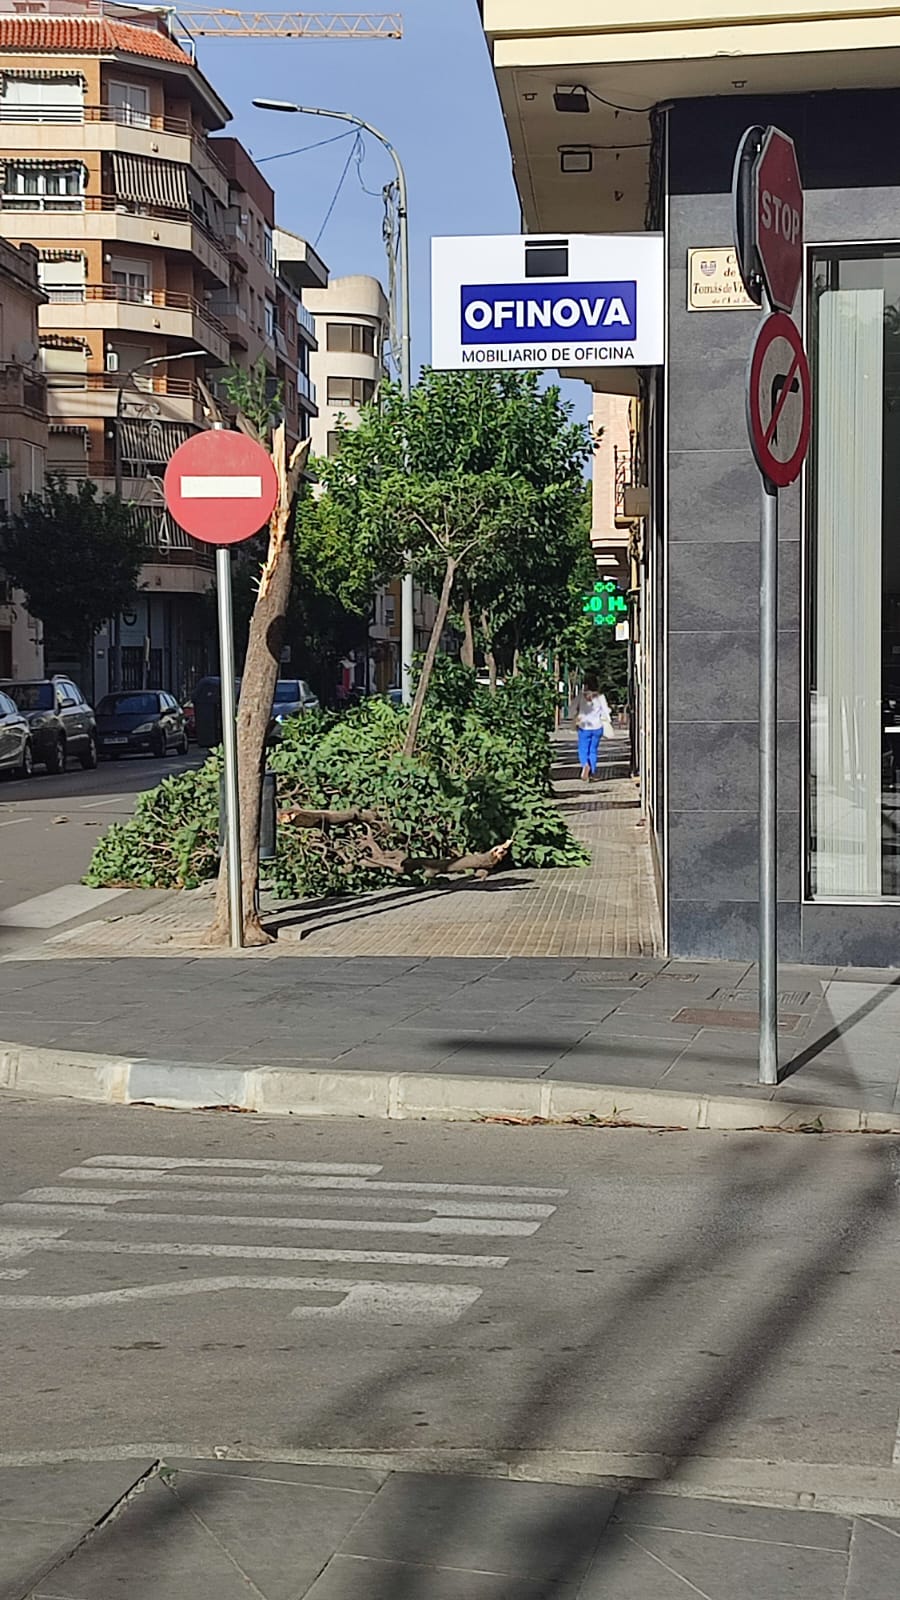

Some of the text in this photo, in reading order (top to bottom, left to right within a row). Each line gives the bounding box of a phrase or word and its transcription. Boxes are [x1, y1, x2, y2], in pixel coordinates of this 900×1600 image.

[761, 189, 800, 245] STOP
[464, 297, 631, 330] OFINOVA
[462, 346, 635, 363] MOBILIARIO DE OFICINA
